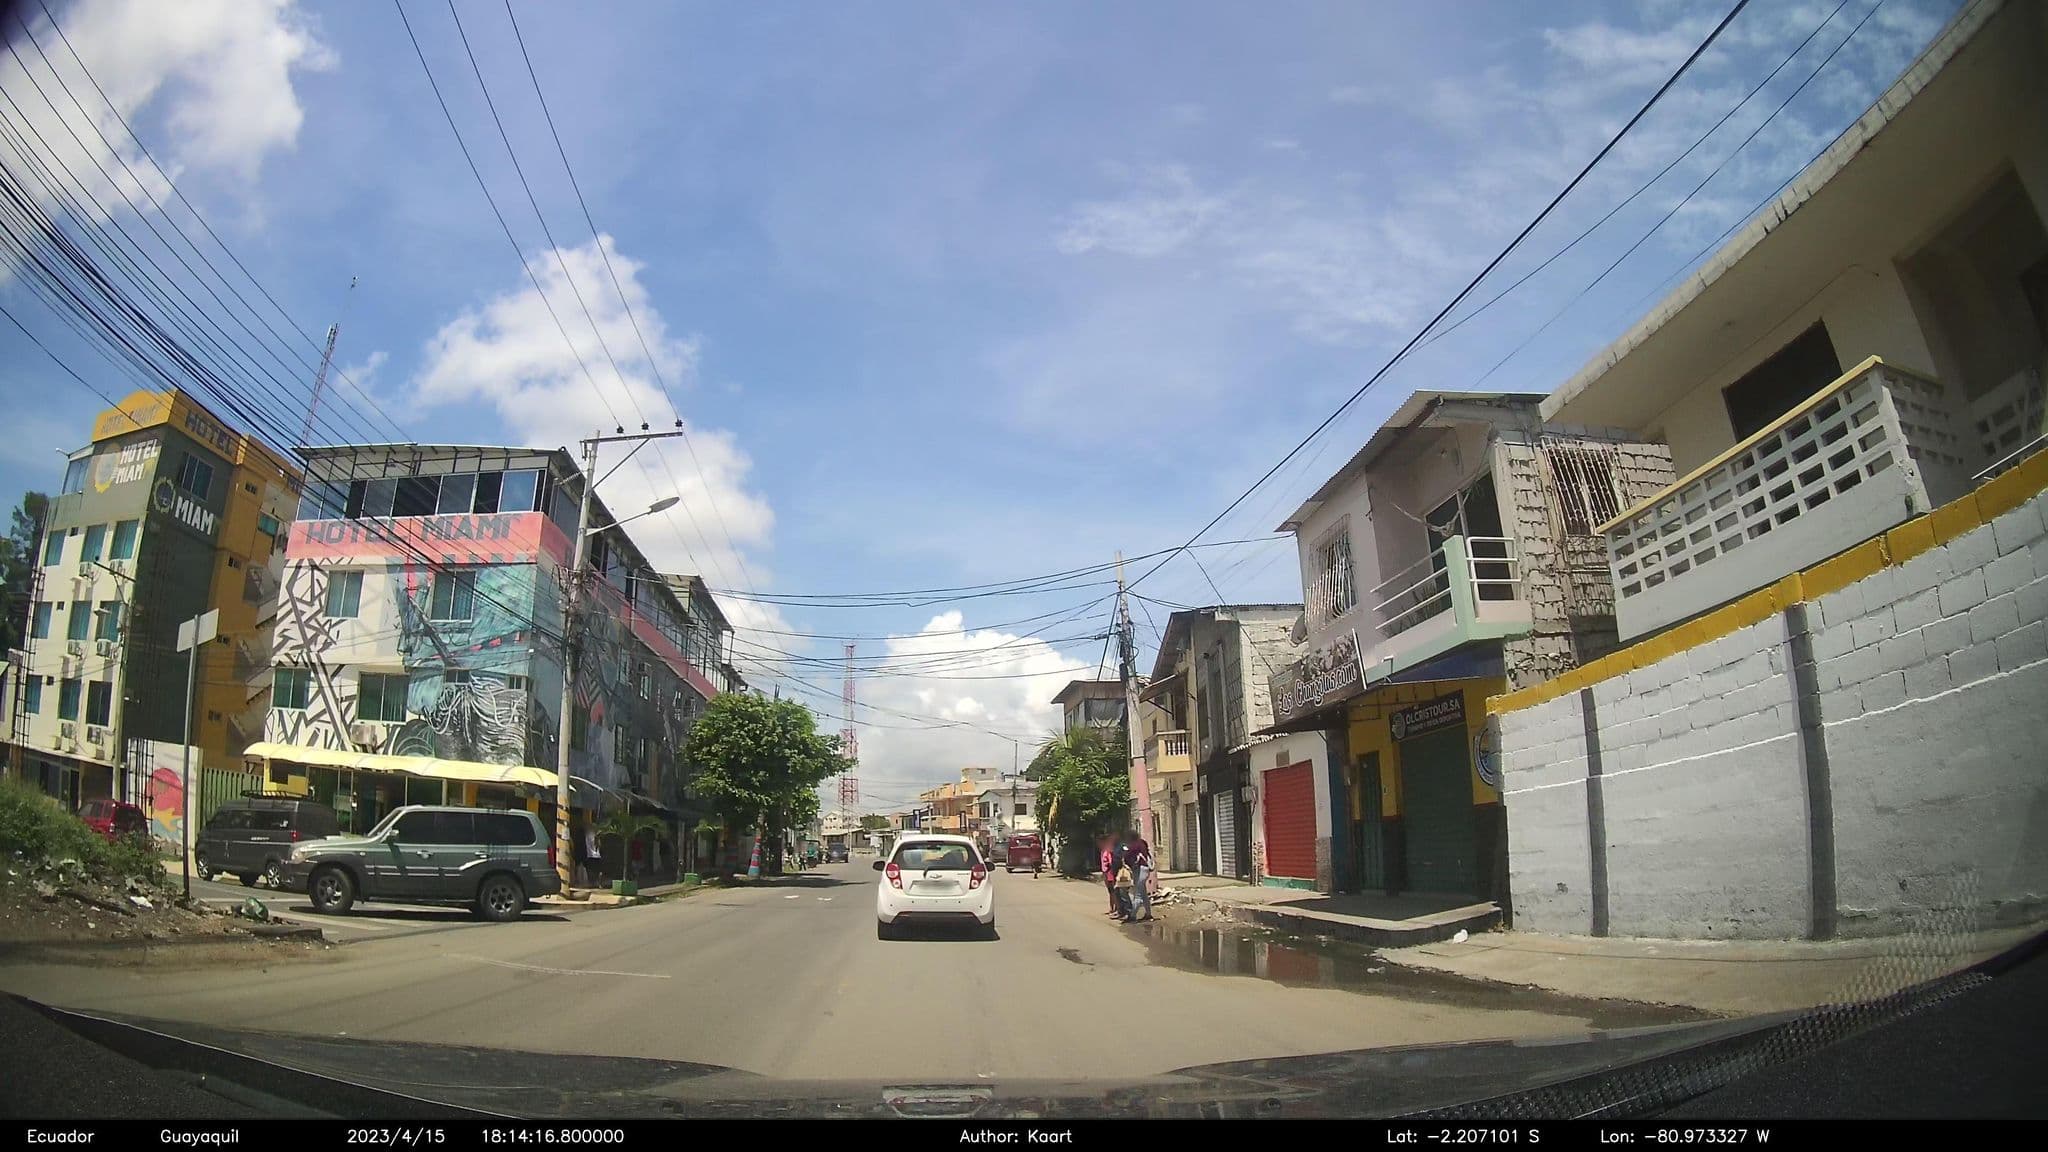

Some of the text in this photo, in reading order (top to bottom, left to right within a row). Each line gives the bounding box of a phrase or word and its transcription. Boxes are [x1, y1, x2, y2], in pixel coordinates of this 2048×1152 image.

[119, 438, 158, 465] HOTEL
[305, 513, 517, 545] HOTEL MIAMI
